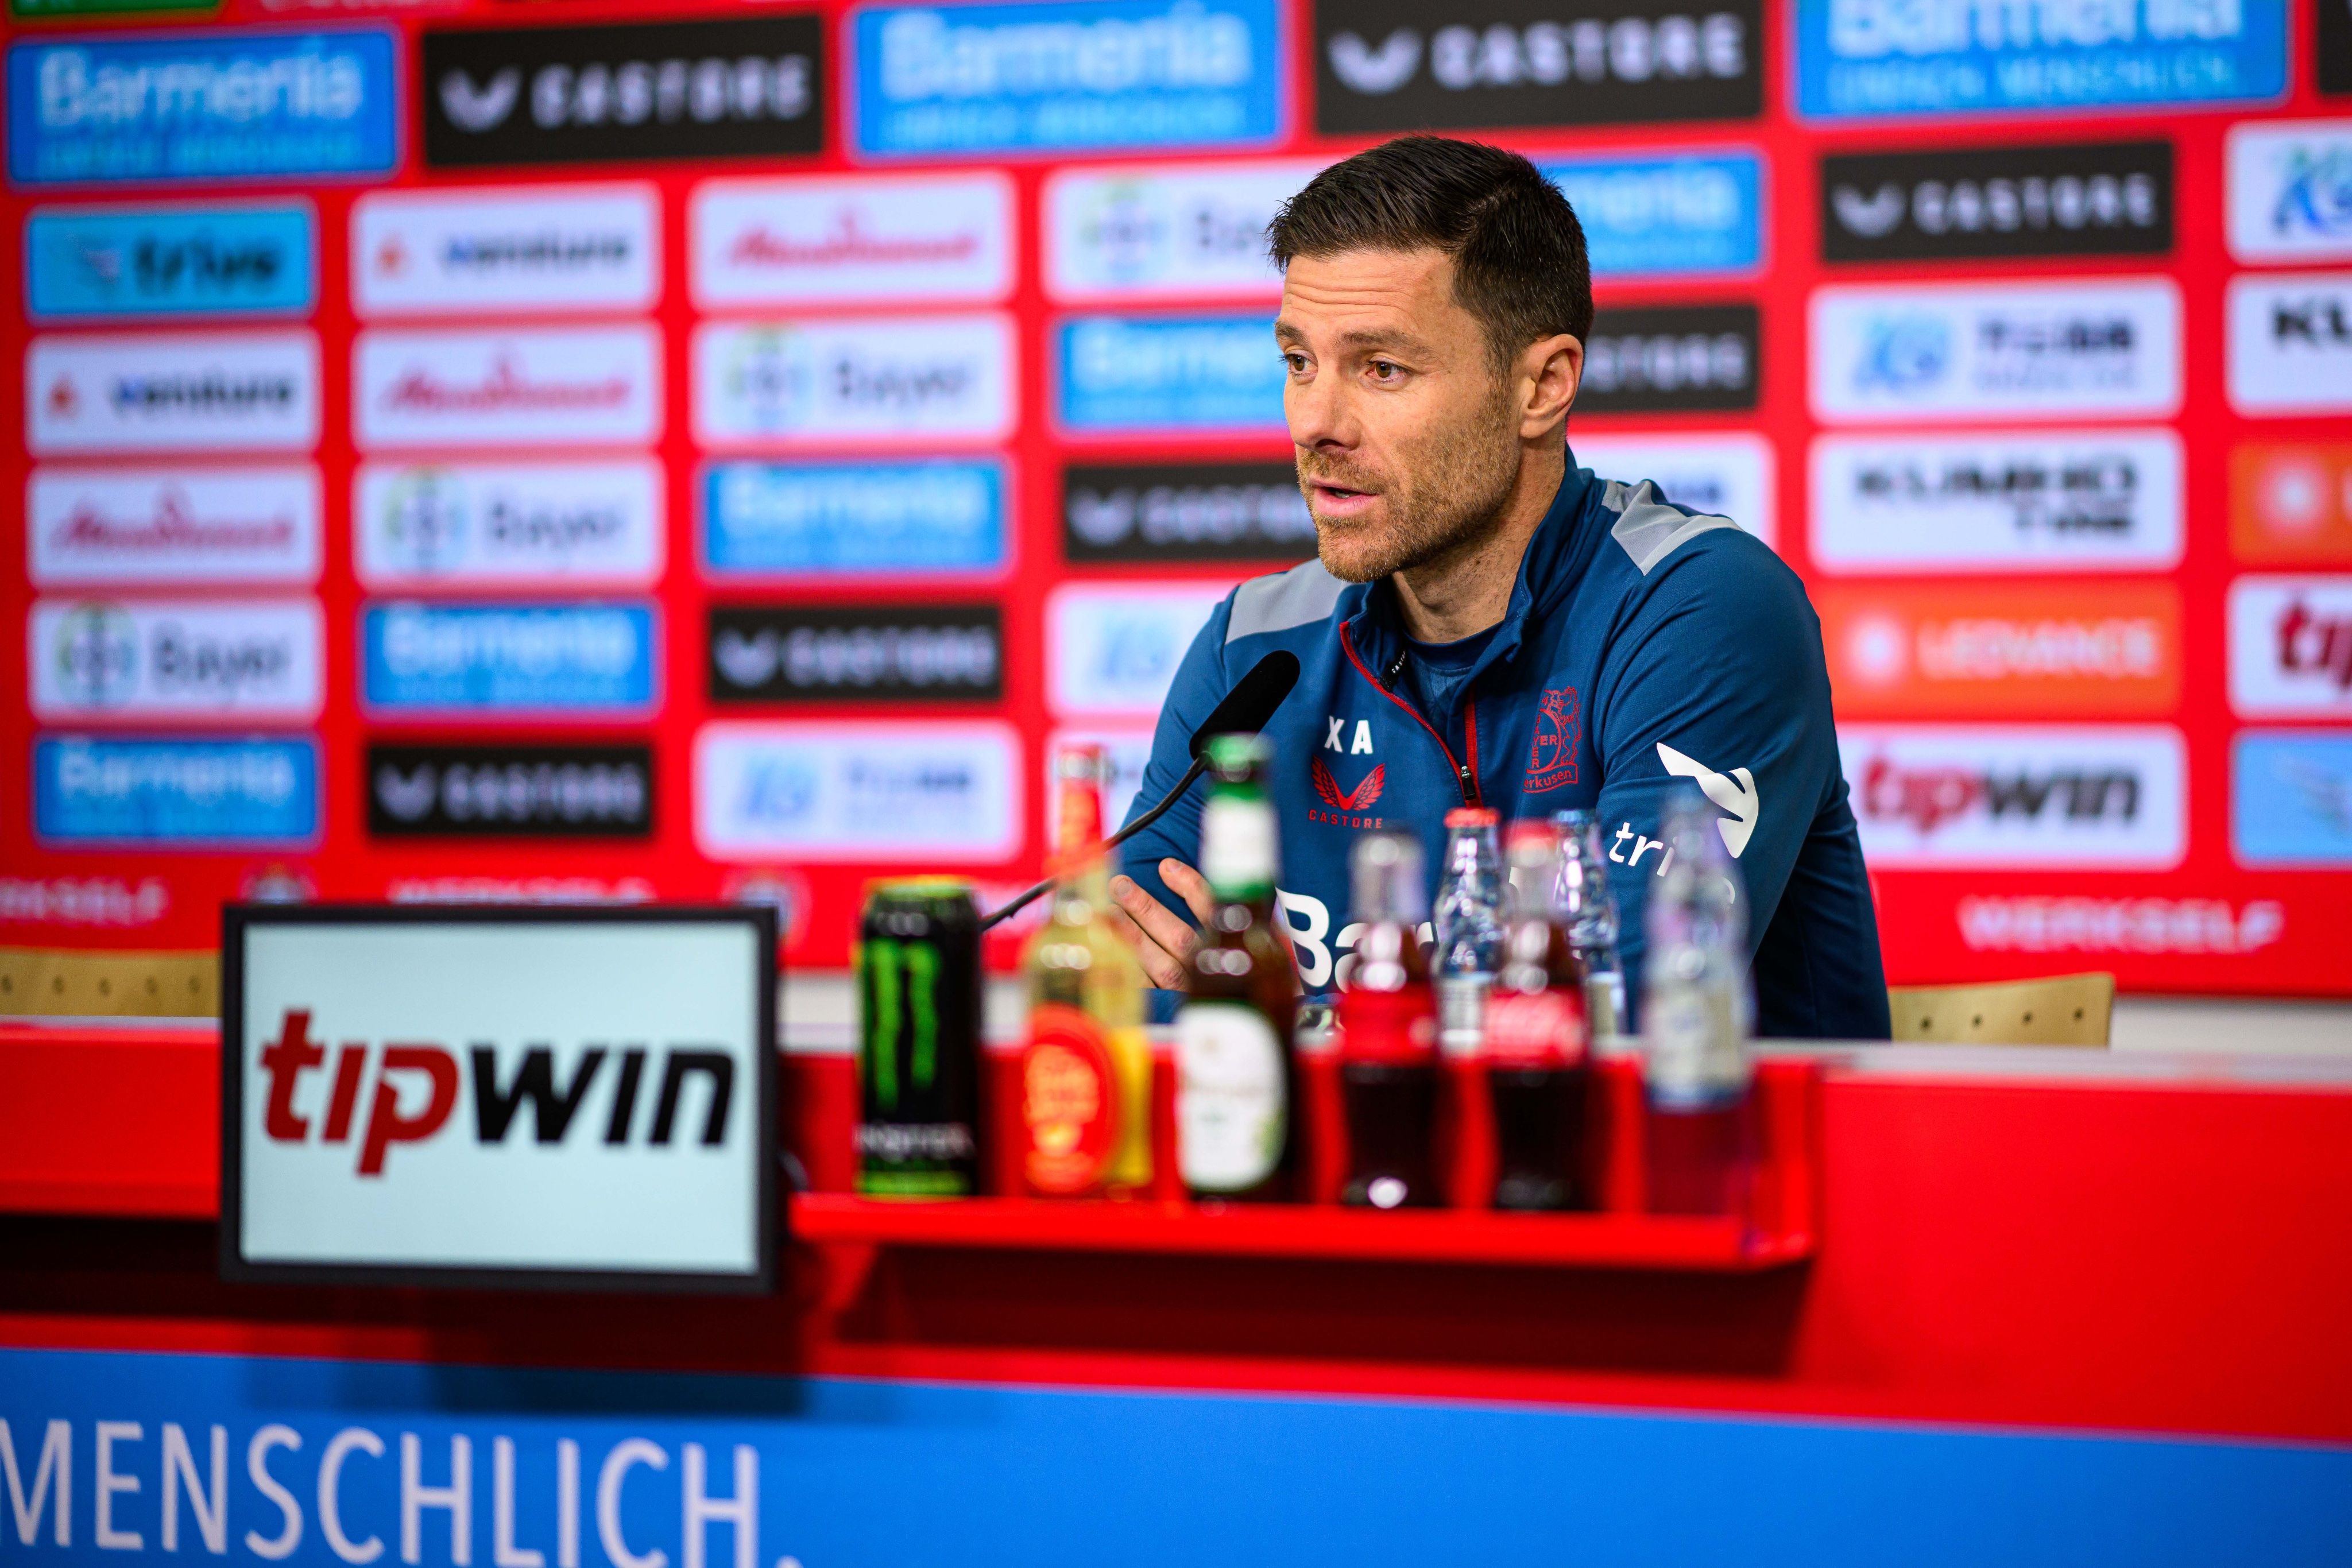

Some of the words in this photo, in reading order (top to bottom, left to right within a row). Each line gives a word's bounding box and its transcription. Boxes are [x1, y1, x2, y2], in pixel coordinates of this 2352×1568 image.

[1324, 715, 1345, 753] X
[1351, 719, 1374, 755] A
[1309, 809, 1383, 830] CASTORE
[260, 1008, 736, 1179] tipwin
